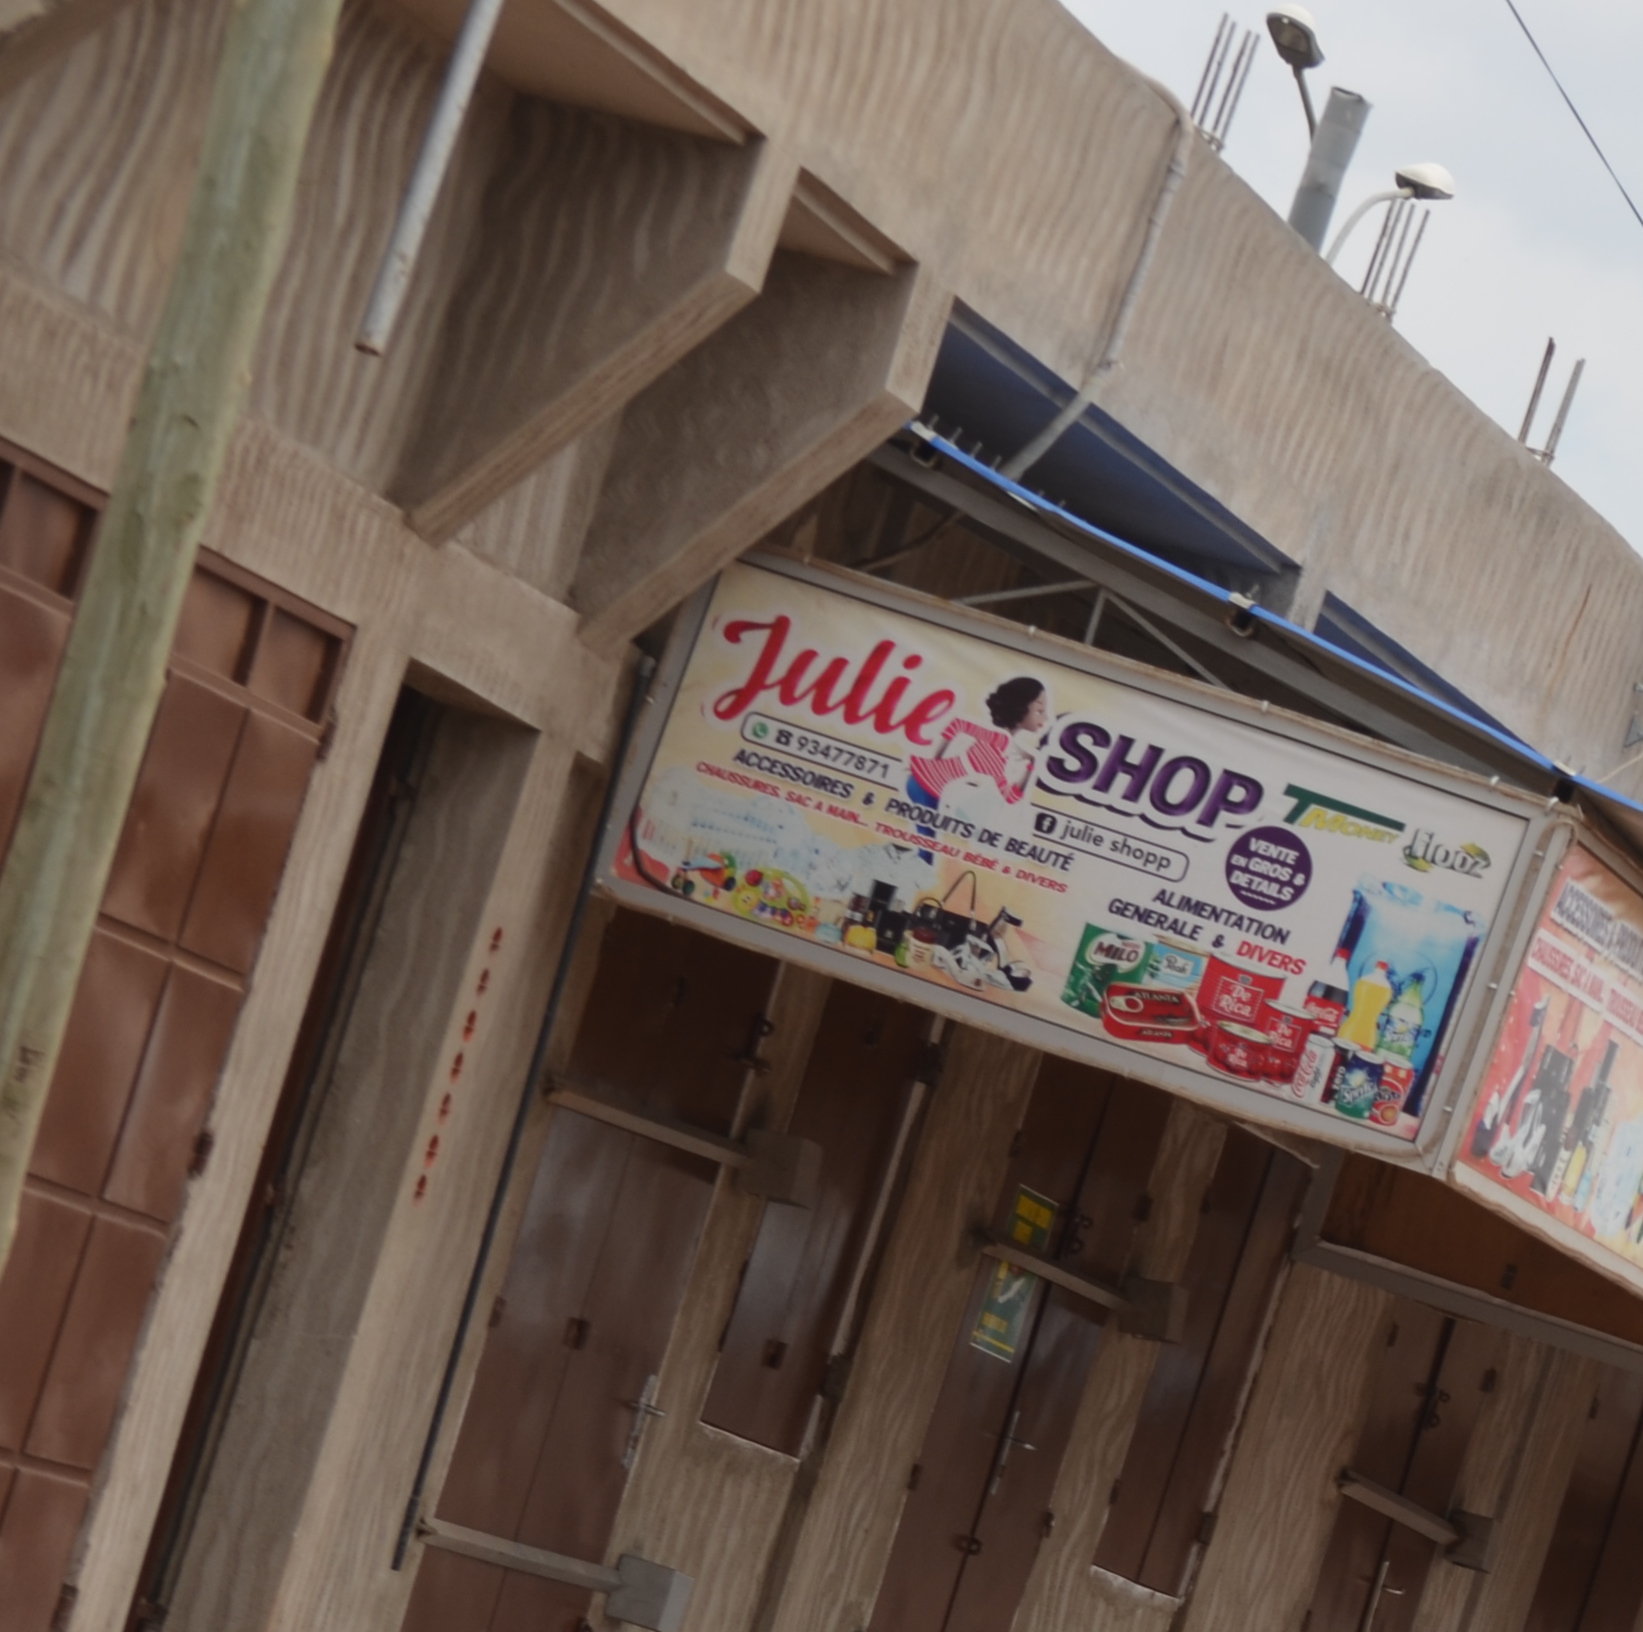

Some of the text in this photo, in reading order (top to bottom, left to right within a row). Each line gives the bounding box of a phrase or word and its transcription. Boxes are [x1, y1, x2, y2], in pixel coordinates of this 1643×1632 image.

[713, 615, 956, 746] Julie
[797, 736, 890, 778] 93477871
[1047, 721, 1264, 828] SHOP
[732, 749, 1075, 872] ACCESSOIRES & PRODUITS DE BEAUTÉ
[785, 791, 812, 808] SAC
[875, 822, 960, 857] TROUSSEAU
[1015, 869, 1069, 893] DIVERS
[1060, 821, 1104, 847] julie
[1109, 839, 1171, 872] shopp
[1248, 856, 1293, 882] GROS
[1249, 837, 1299, 865] VENTE
[1229, 870, 1295, 902] DETAILS
[1108, 898, 1308, 975] GENERALE & DIVERS
[1152, 888, 1291, 946] ALIMENTATION
